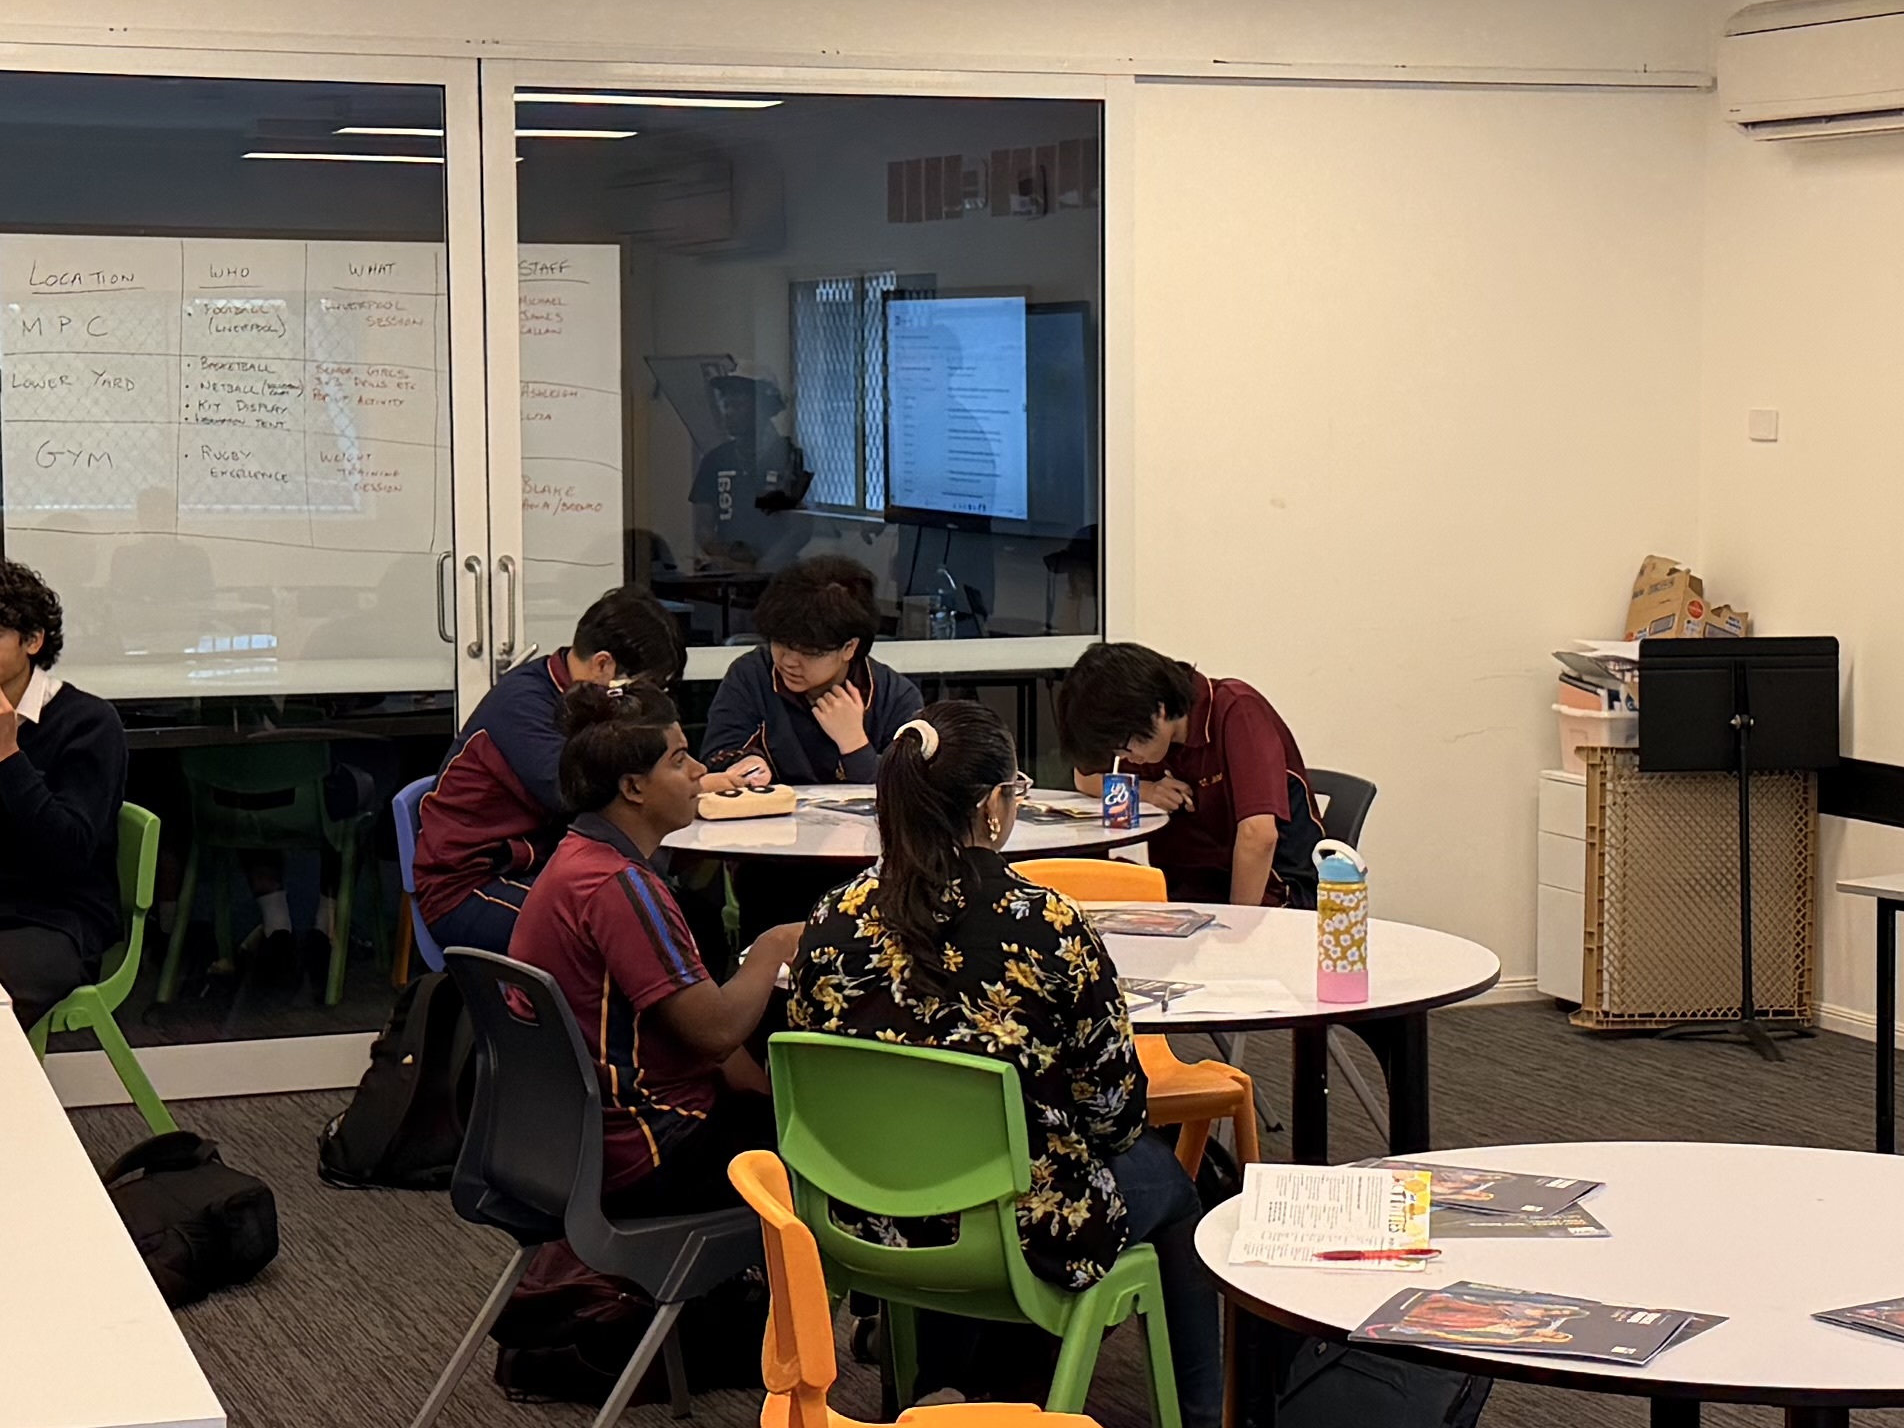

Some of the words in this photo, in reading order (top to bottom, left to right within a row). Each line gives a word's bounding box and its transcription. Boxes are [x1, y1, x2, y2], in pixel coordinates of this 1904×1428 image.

[209, 264, 250, 278] WHO
[348, 262, 396, 277] WHAT
[518, 259, 572, 276] STAFF
[35, 440, 114, 470] GYM
